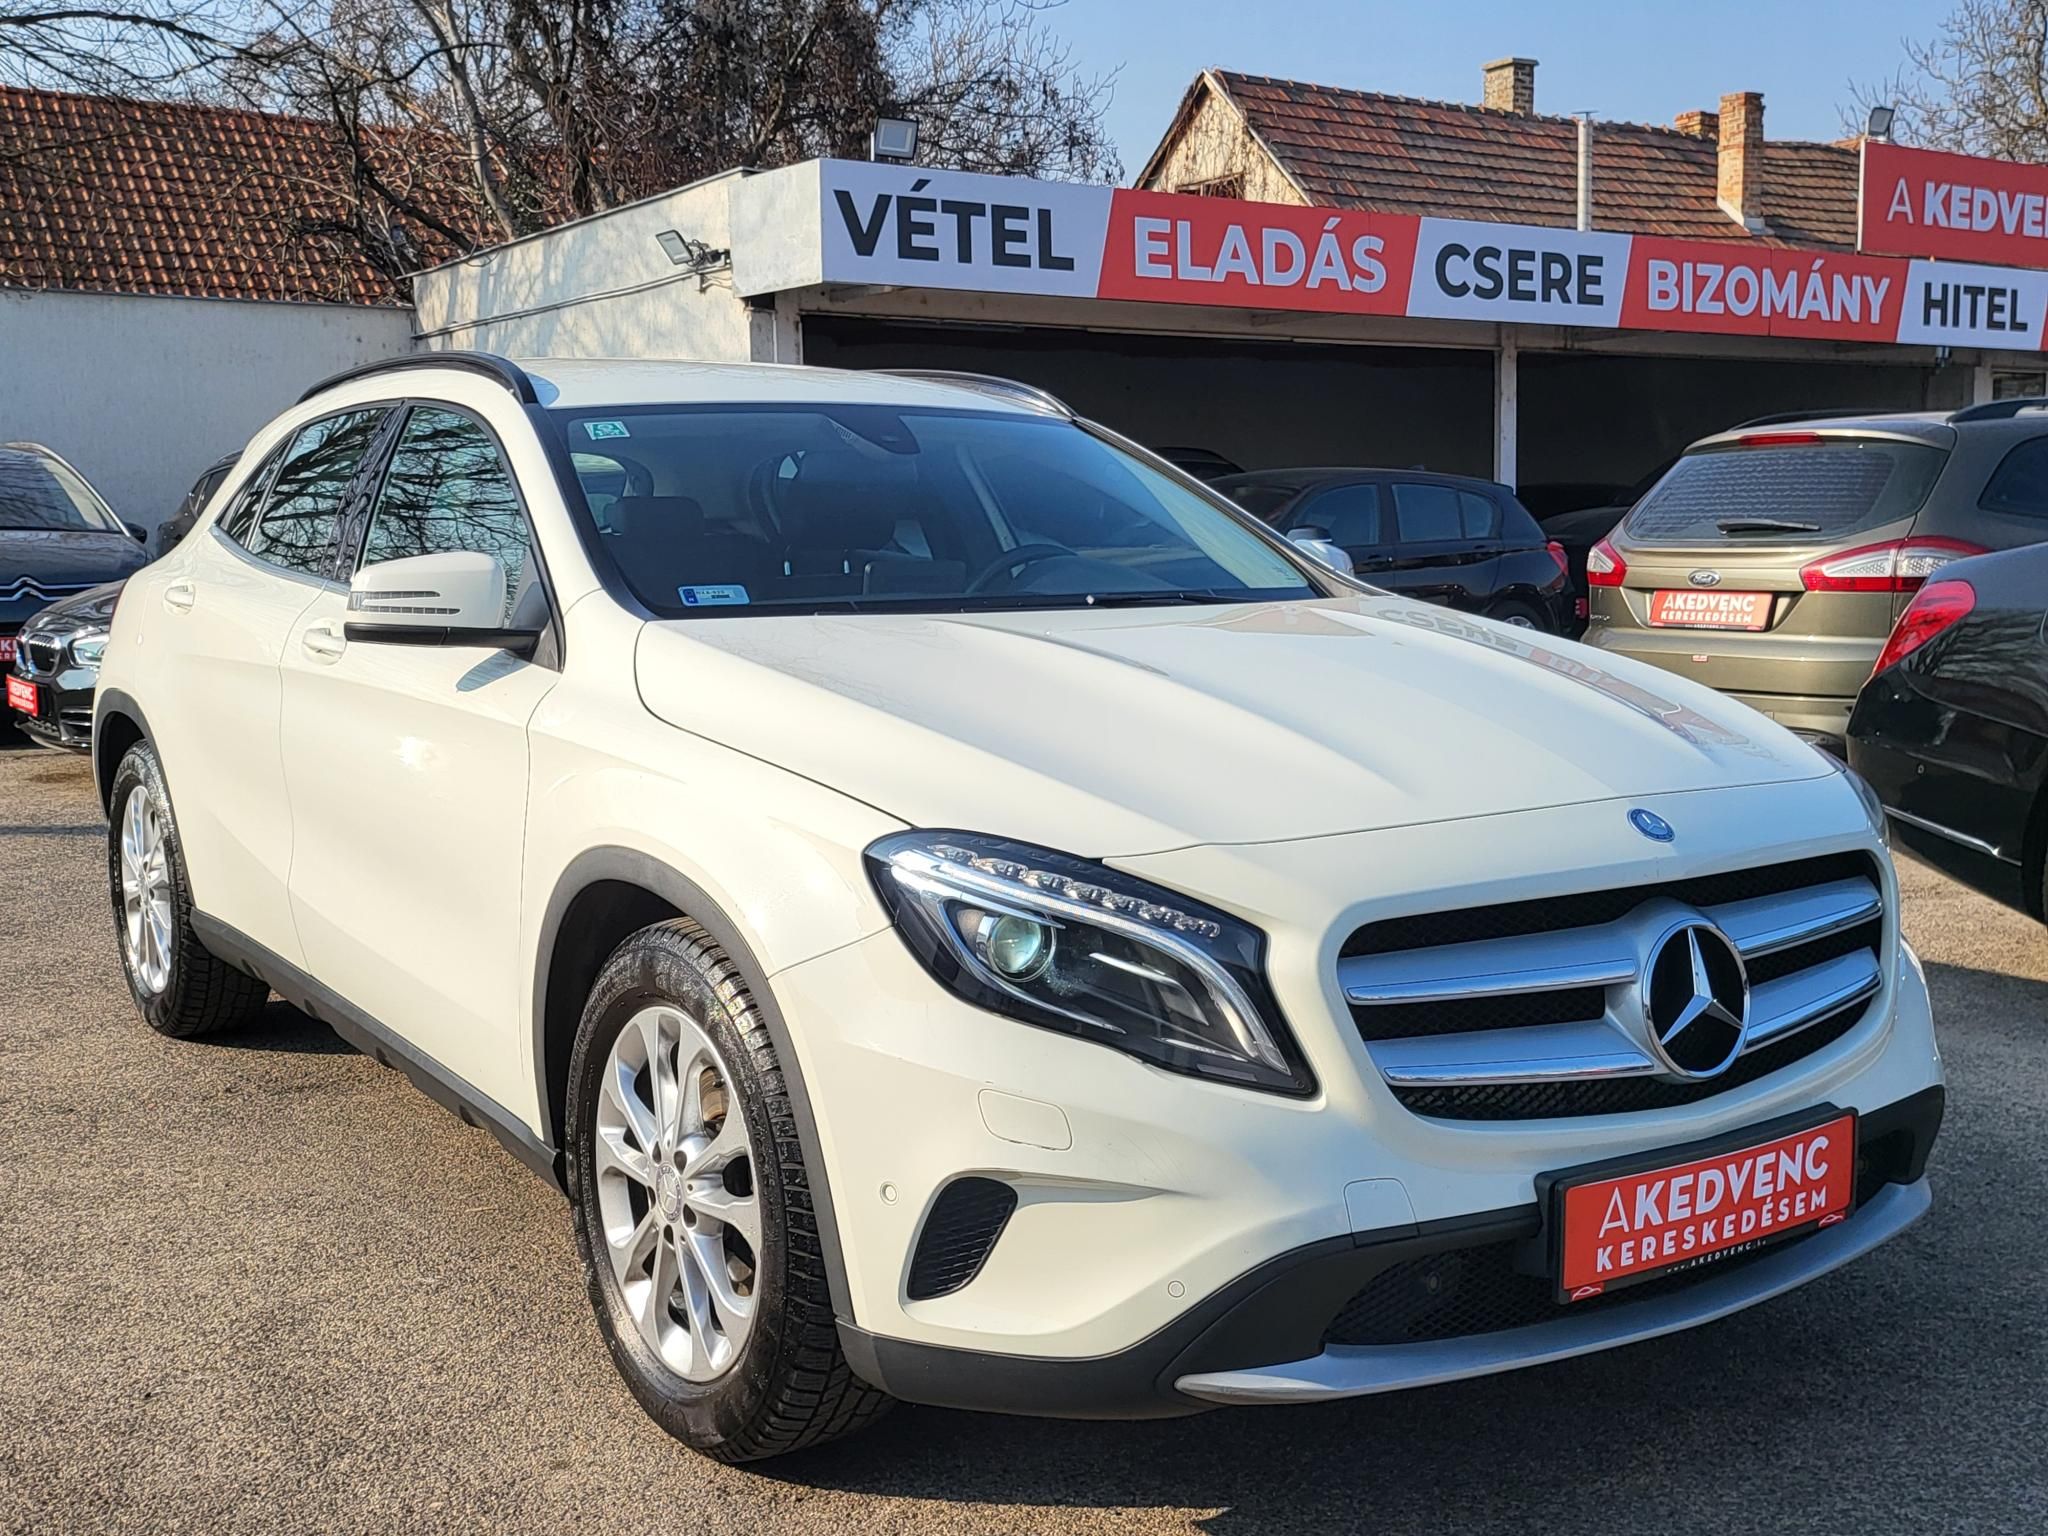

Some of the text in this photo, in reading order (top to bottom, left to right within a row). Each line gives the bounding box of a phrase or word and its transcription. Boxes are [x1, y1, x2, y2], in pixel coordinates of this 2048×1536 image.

[1887, 177, 2048, 239] A KEDVE
[833, 179, 2028, 332] VÉTEL ELADÁS CSERE BIZOMÁNY HITEL
[1660, 609, 1753, 623] KERESKEDÉSEM
[1596, 1185, 1827, 1273] KERESKEDÉSEM
